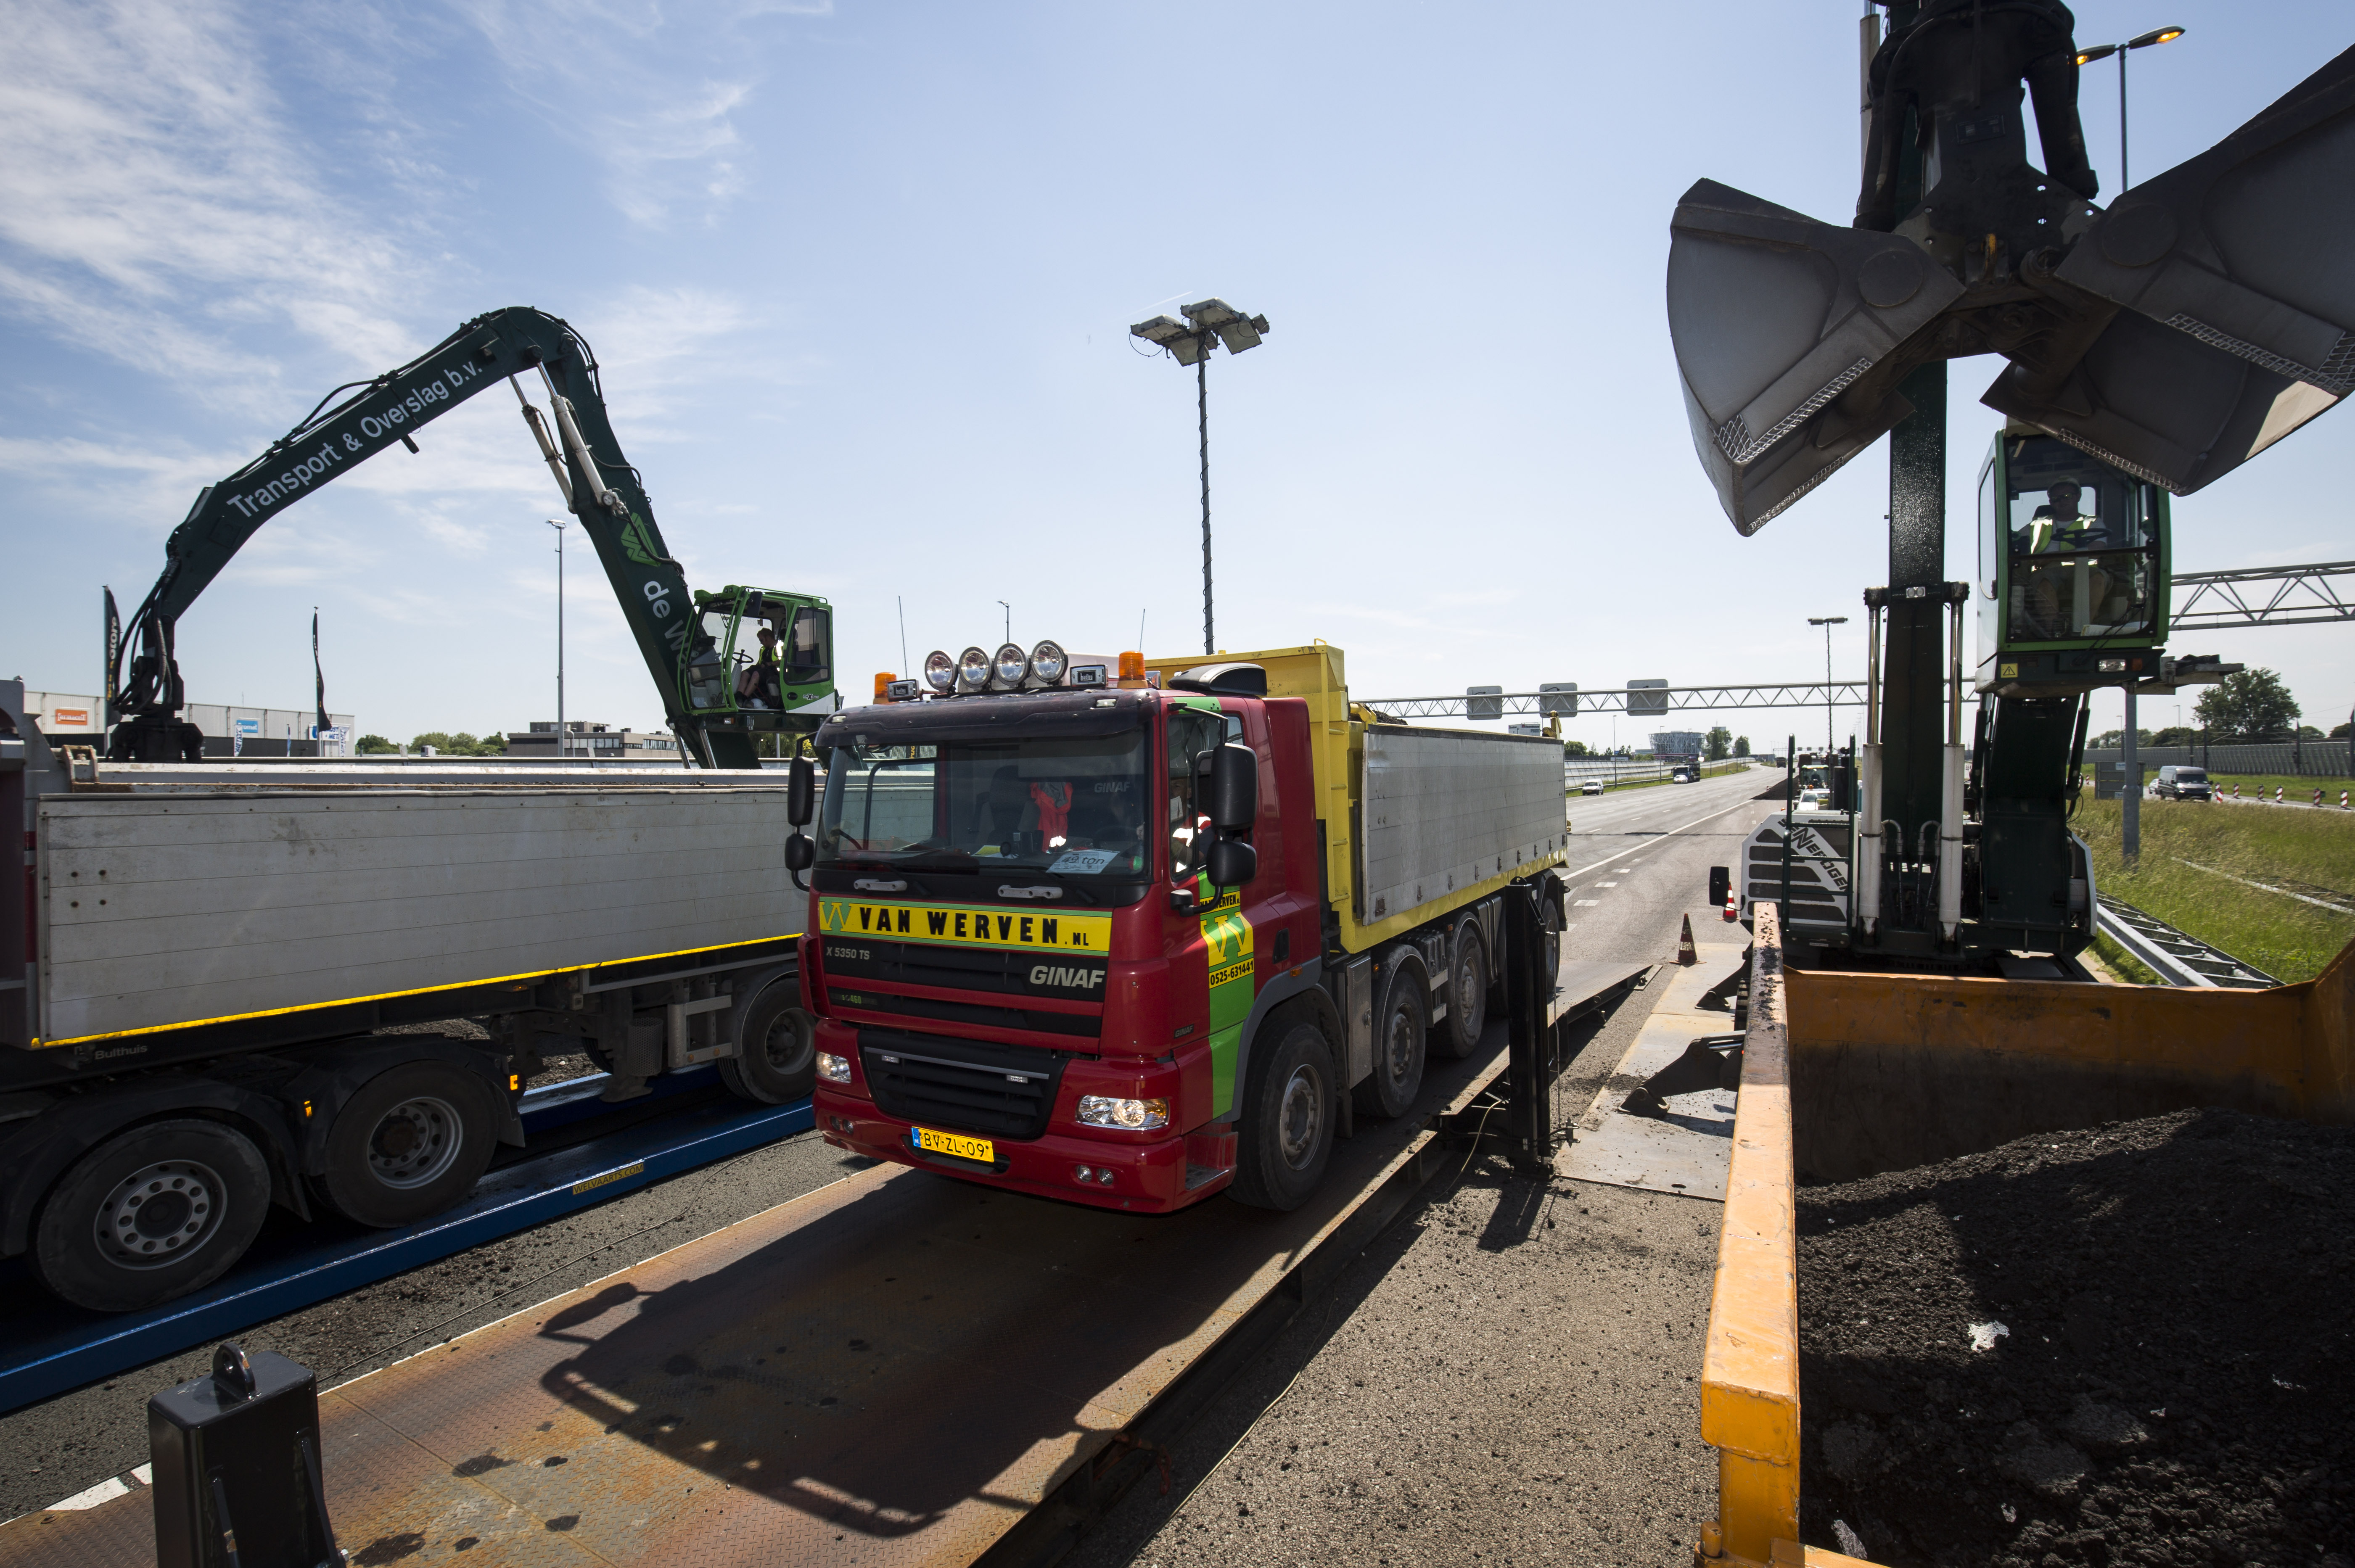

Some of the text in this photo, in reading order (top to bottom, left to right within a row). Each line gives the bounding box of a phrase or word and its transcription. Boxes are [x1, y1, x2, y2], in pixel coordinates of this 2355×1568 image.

[226, 359, 483, 518] Transport & Overslag b.v.
[643, 580, 670, 618] de
[1094, 781, 1131, 793] GINAF
[859, 907, 911, 933] VAN
[826, 947, 870, 960] X 5350 TS
[1030, 965, 1105, 989] GINAF
[1210, 960, 1254, 985] 0525-631441
[1175, 1025, 1193, 1037] GINAF
[95, 1045, 147, 1060] Bulthuis
[924, 1132, 984, 1157] BV-ZL-09
[574, 1164, 643, 1193] WELVAARTS.COM
